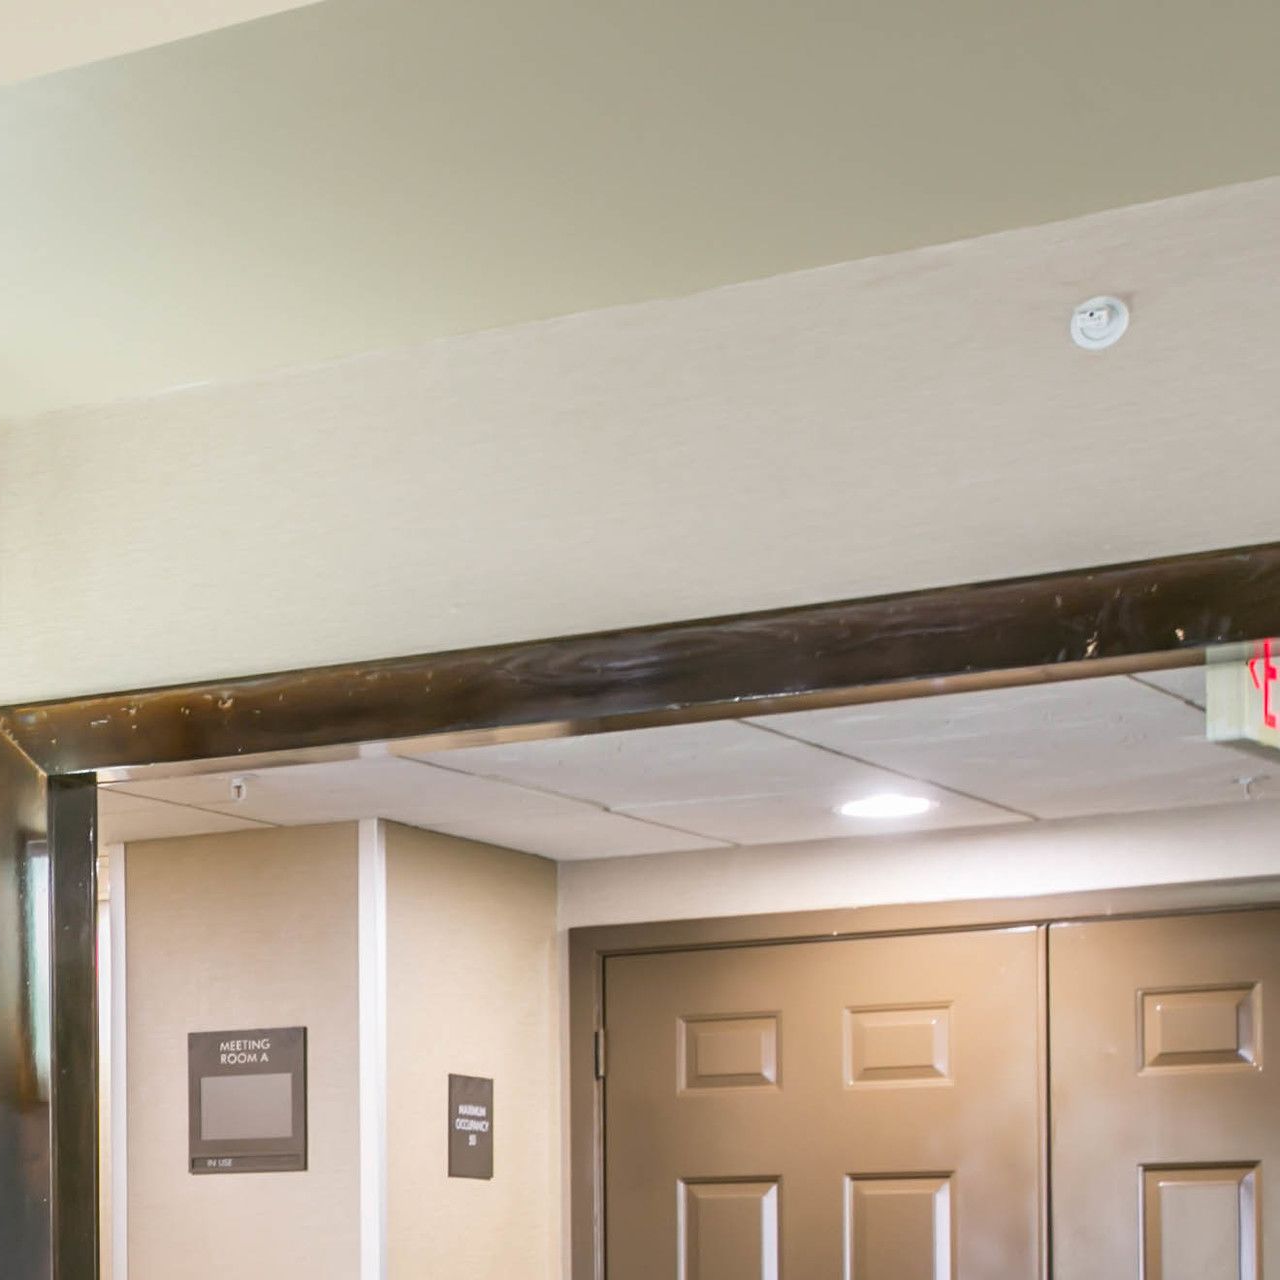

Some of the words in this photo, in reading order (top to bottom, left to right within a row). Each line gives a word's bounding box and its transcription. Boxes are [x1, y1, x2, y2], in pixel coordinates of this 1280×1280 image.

[219, 1038, 271, 1052] MEETING
[220, 1052, 258, 1065] ROOM
[260, 1053, 270, 1063] A
[207, 1159, 217, 1168] IN
[218, 1158, 233, 1168] USE
